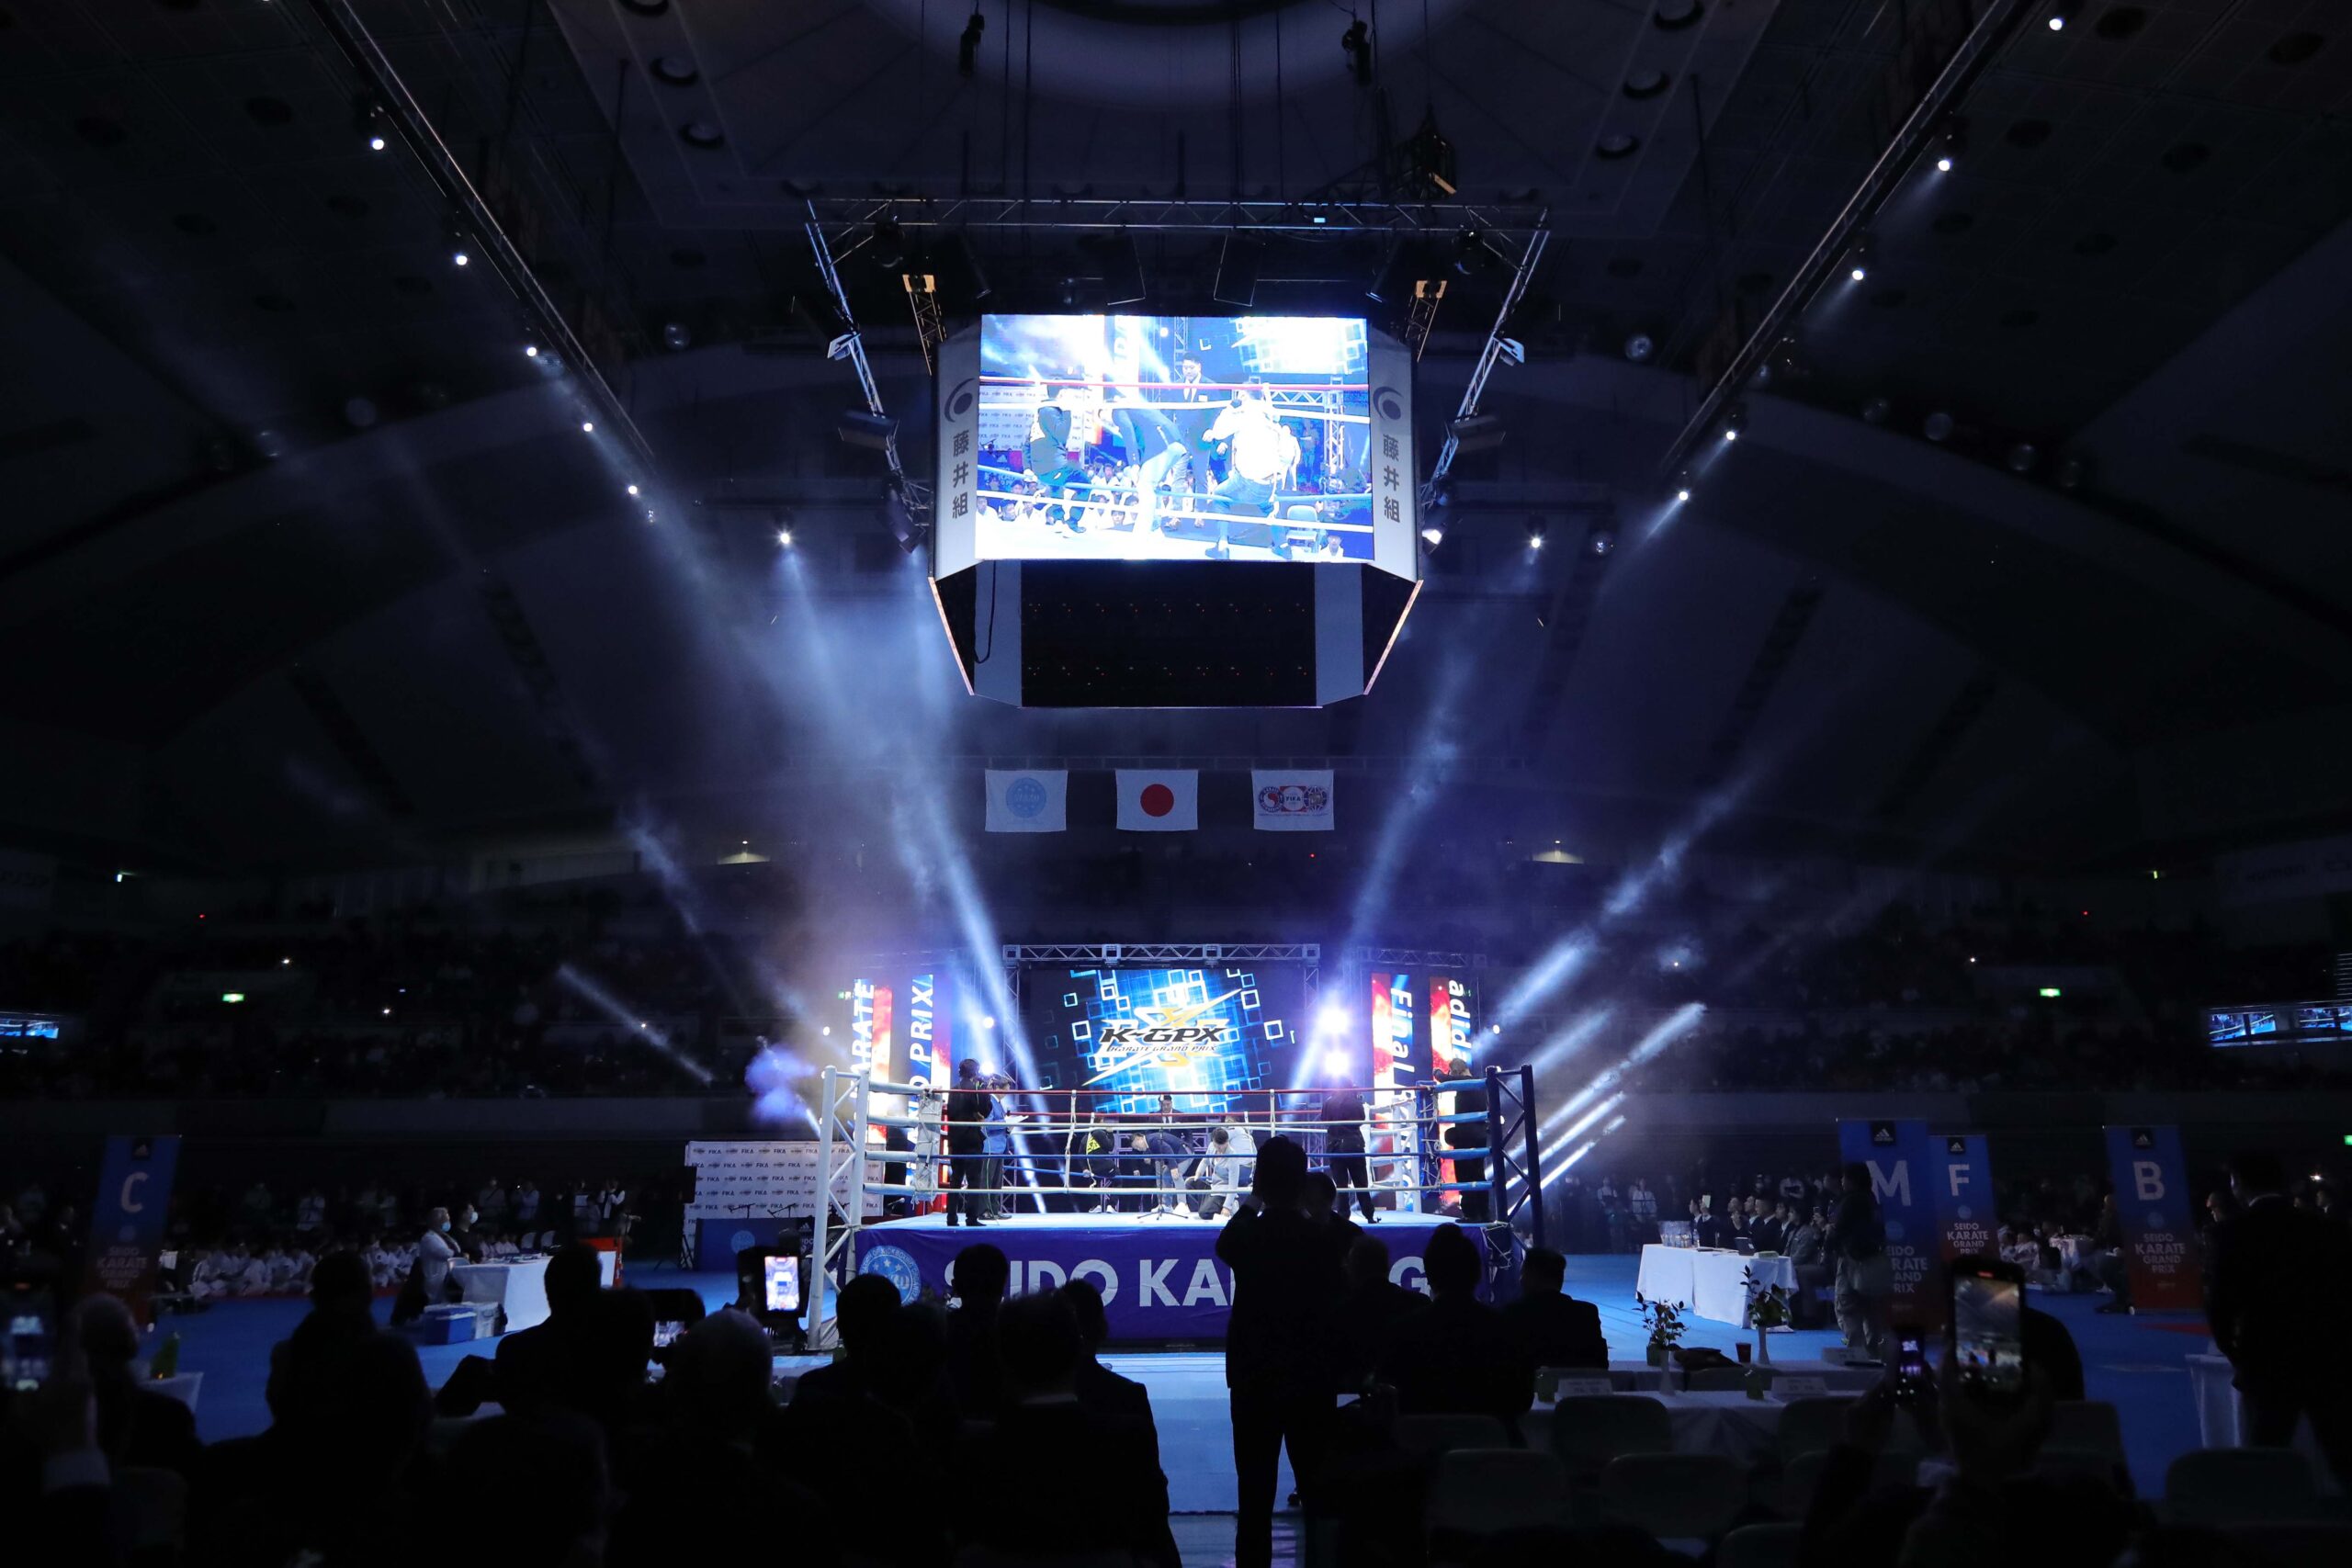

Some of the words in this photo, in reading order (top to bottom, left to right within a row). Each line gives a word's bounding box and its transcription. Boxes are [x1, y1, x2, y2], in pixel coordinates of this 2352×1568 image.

[953, 430, 969, 519] 藤井組
[1383, 434, 1400, 523] 藤井組
[910, 986, 933, 1063] PRIX
[1391, 987, 1415, 1073] Final
[1100, 1028, 1227, 1042] K-GPX
[1866, 1160, 1911, 1206] M
[1948, 1164, 1970, 1196] F
[2132, 1161, 2165, 1201] B
[121, 1172, 150, 1213] C
[1947, 1231, 1989, 1240] KARATE
[2143, 1233, 2174, 1243] SEIDO
[1953, 1240, 1984, 1248] GRAND
[2134, 1243, 2187, 1255] KARATE
[1886, 1246, 1915, 1257] EIDO
[1891, 1257, 1928, 1270] RATE
[2143, 1255, 2181, 1264] GRAND
[2151, 1264, 2176, 1273] PRIX
[1894, 1271, 1922, 1282] AND
[1894, 1283, 1915, 1293] RIX
